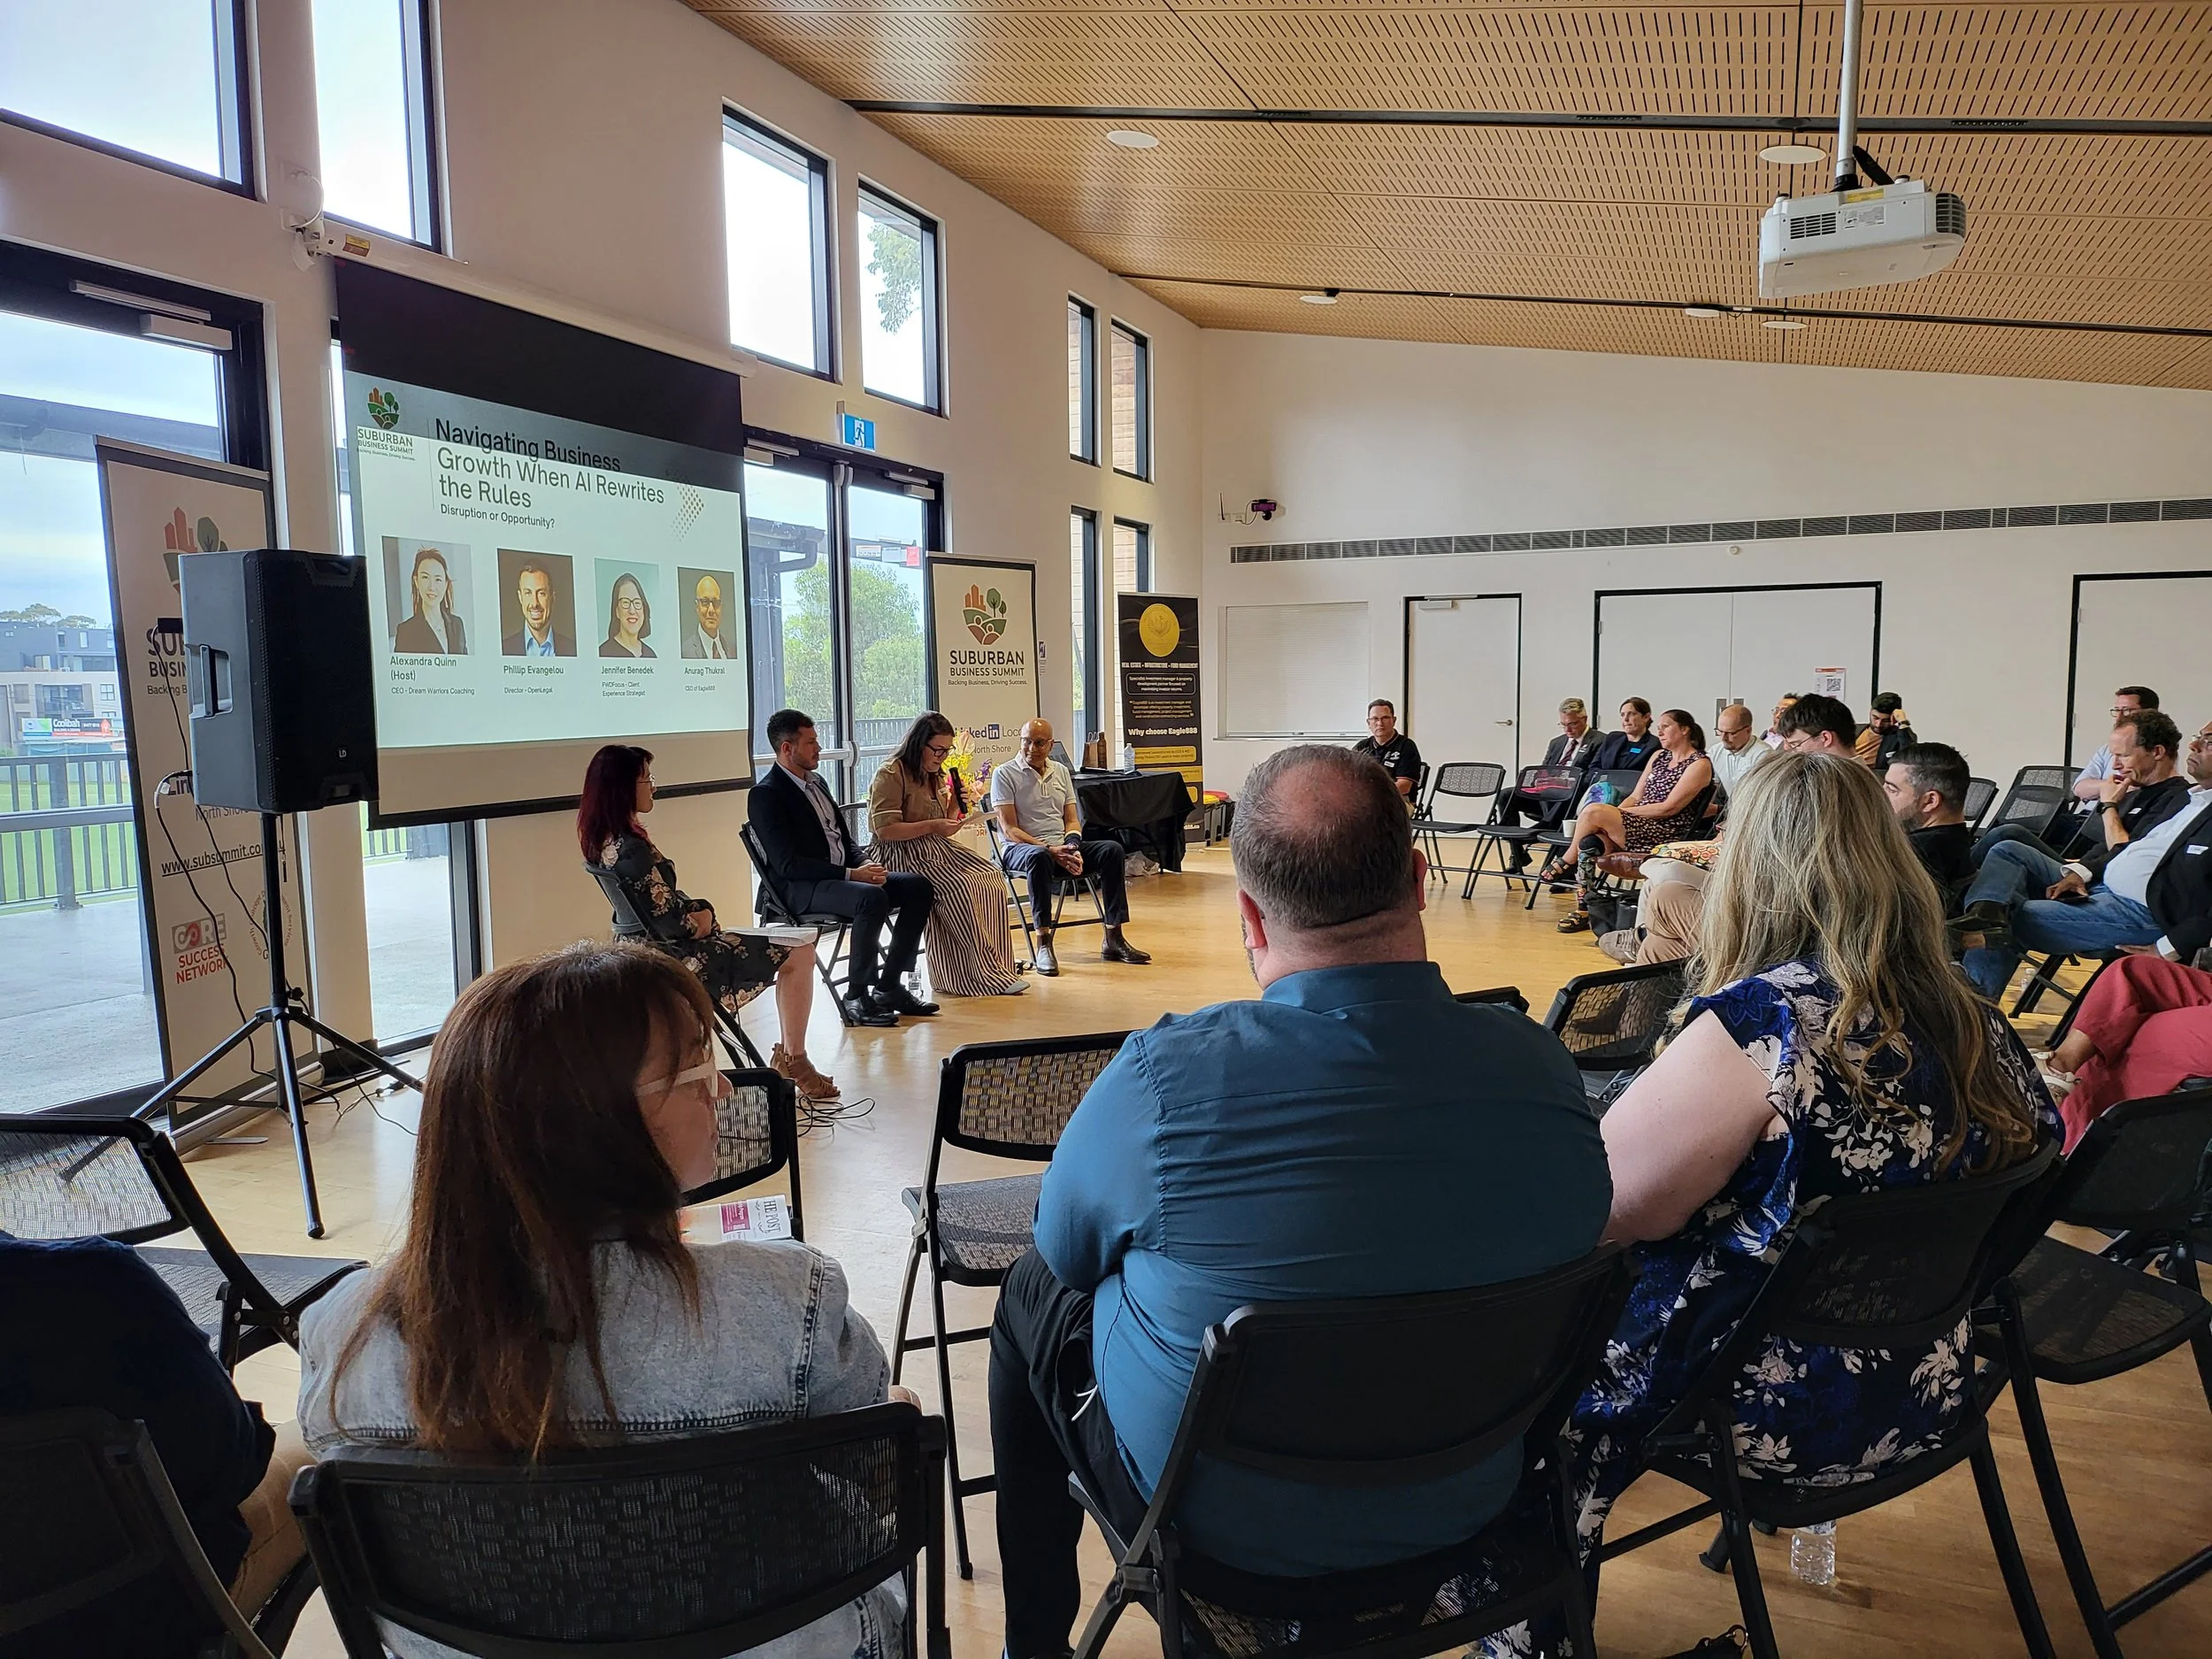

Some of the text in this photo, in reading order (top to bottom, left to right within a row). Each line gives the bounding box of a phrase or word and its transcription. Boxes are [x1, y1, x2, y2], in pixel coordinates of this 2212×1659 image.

[357, 428, 413, 448] SUBURBAN
[435, 419, 621, 471] Navigating Business
[357, 440, 413, 455] BUSINESS SUMMIT
[437, 446, 664, 503] Growth When AI Rewrites
[439, 473, 532, 508] the Rules
[441, 503, 555, 529] Disruption or Opportunity?
[390, 656, 457, 667] Alexandra Quinn
[949, 649, 1025, 665] SUBURBAN
[390, 669, 416, 681] (Host)
[527, 665, 565, 676] Evangelou
[684, 666, 704, 676] Anurag
[949, 667, 1025, 676] BUSINESS SUMMIT
[1127, 727, 1145, 736] Why
[991, 744, 1011, 753] Shore
[765, 1213, 781, 1233] POST
